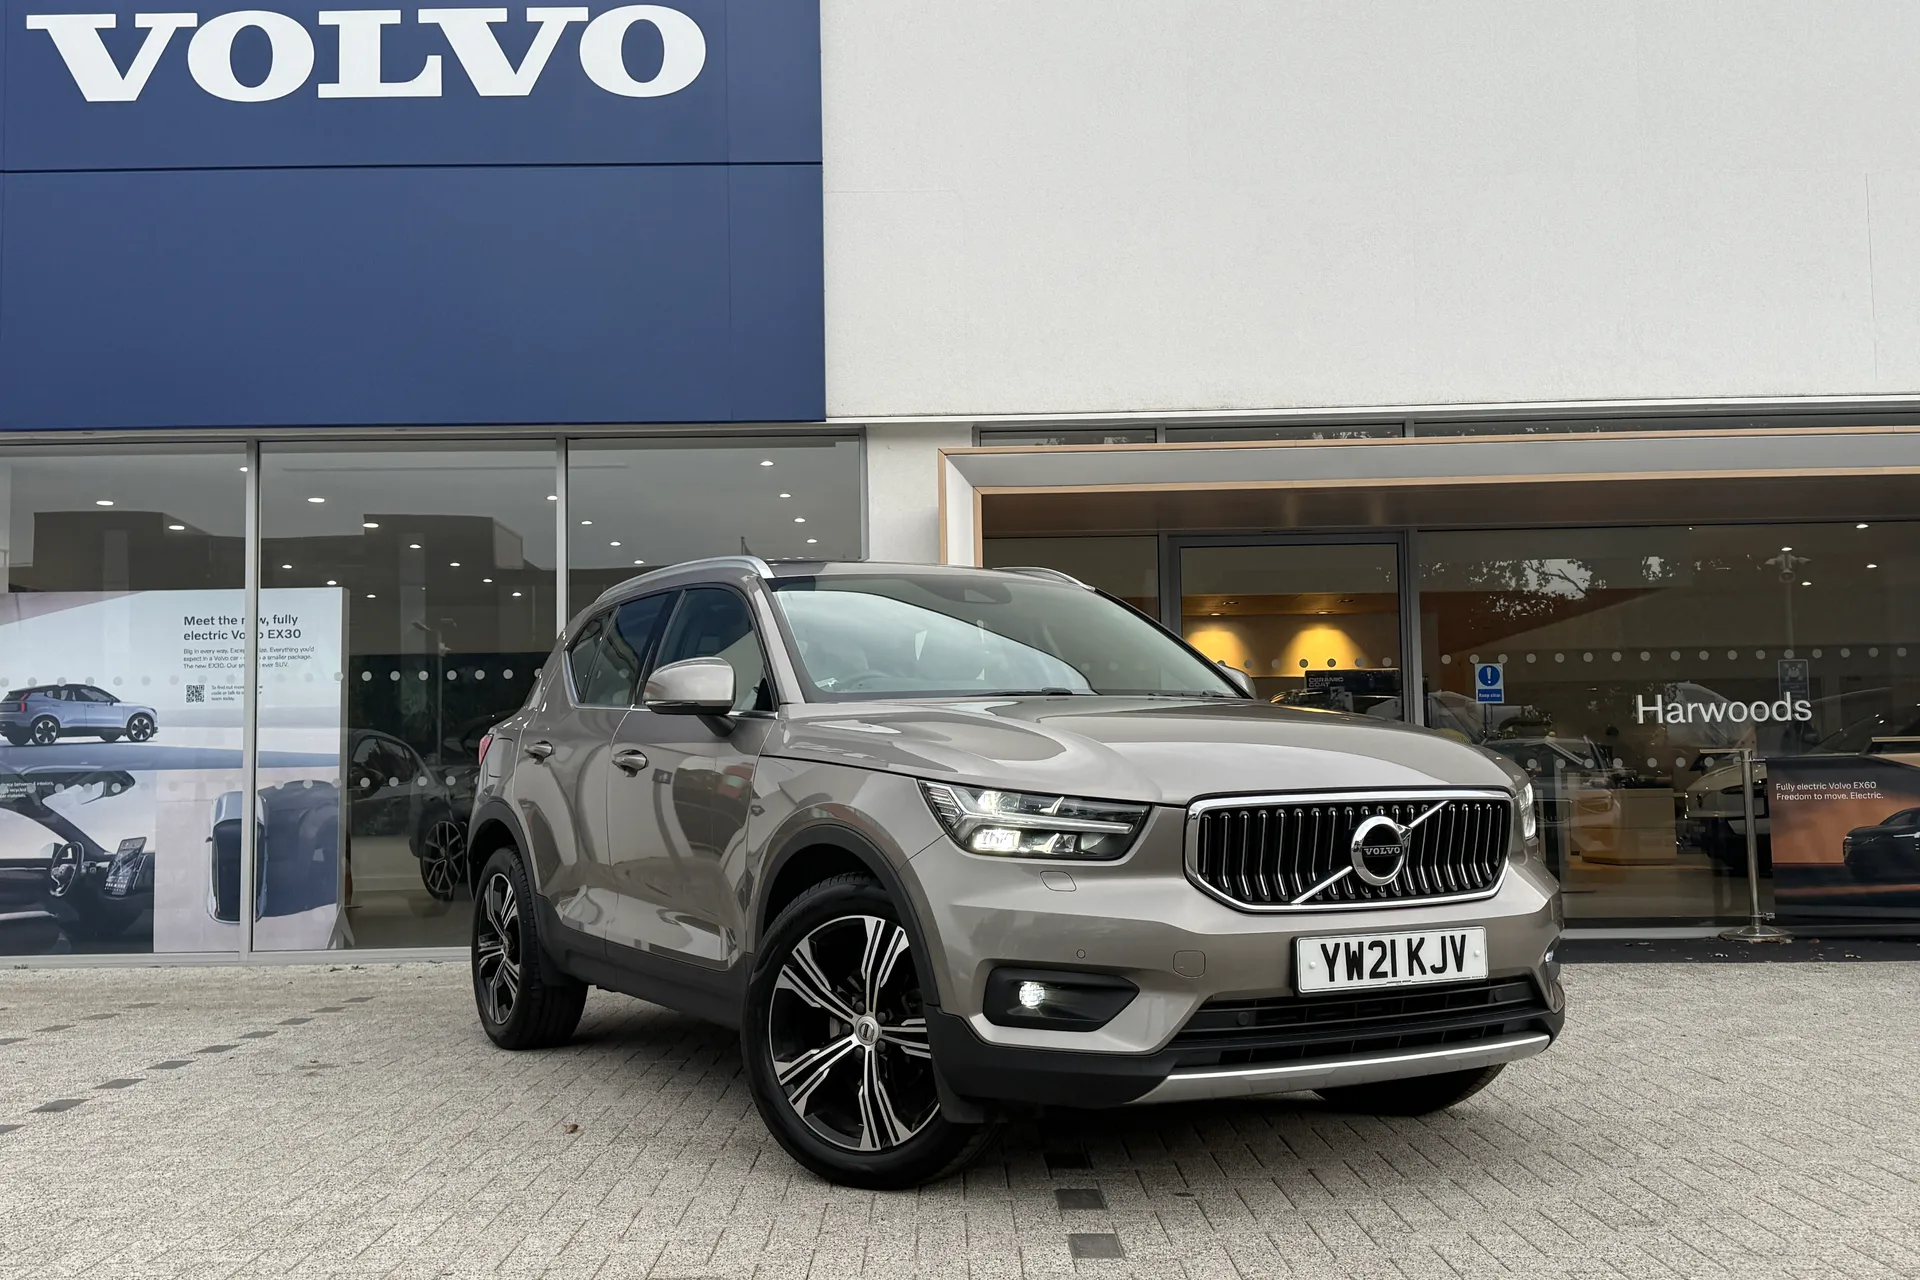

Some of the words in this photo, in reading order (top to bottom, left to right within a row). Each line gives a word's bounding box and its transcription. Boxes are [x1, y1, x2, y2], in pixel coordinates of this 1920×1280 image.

[26, 4, 707, 103] VOLVO
[184, 616, 215, 626] Meet
[218, 615, 238, 625] the
[273, 614, 298, 626] fully
[183, 630, 228, 641] electric
[231, 630, 264, 640] Voo
[268, 629, 301, 639] EX30
[300, 645, 315, 653] you'd
[1636, 691, 1813, 724] Harwoods
[1775, 783, 1795, 792] Fully
[1796, 782, 1827, 790] electric
[1828, 782, 1852, 790] Volvo
[1853, 781, 1877, 789] EX60
[1776, 792, 1812, 801] Freedom
[1814, 792, 1823, 800] to
[1850, 791, 1884, 800] Electric.
[1364, 847, 1401, 855] VOLVO
[1320, 939, 1398, 983] YW21
[1407, 934, 1467, 977] KJV
